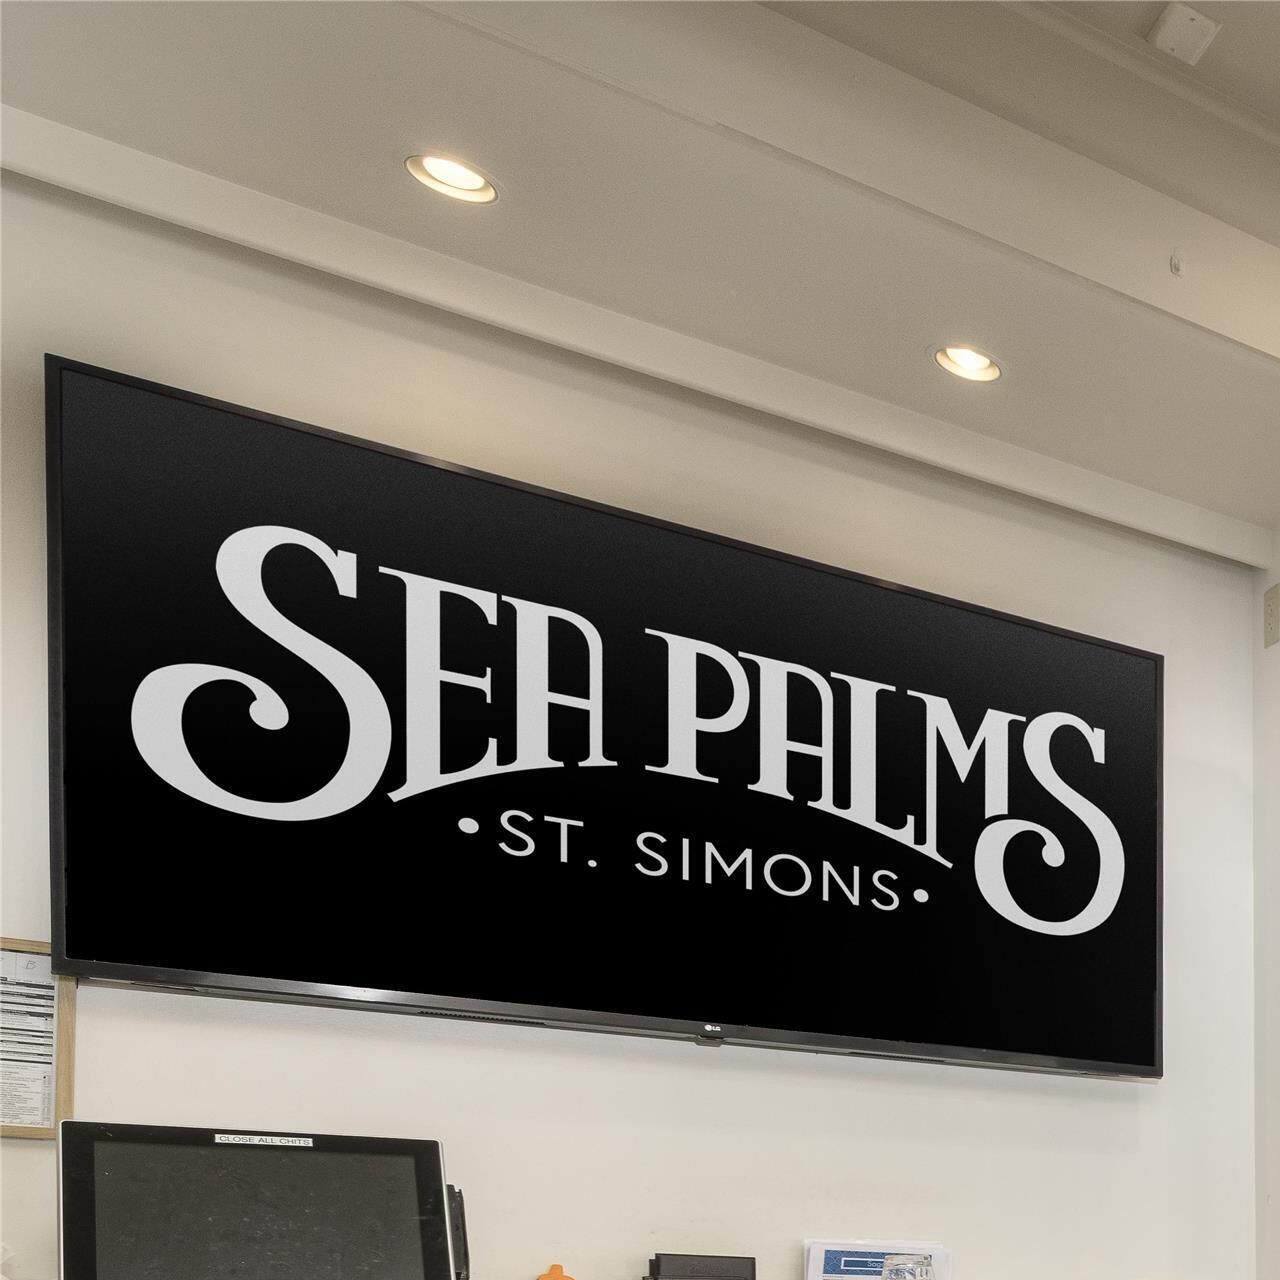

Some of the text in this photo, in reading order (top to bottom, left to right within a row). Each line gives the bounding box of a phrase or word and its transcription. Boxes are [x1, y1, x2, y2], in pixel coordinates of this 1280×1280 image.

[132, 526, 1124, 935] SEA PALMS
[499, 810, 899, 910] ST. SIMONS
[219, 1135, 254, 1143] CLOSE
[280, 1138, 310, 1146] CHITS
